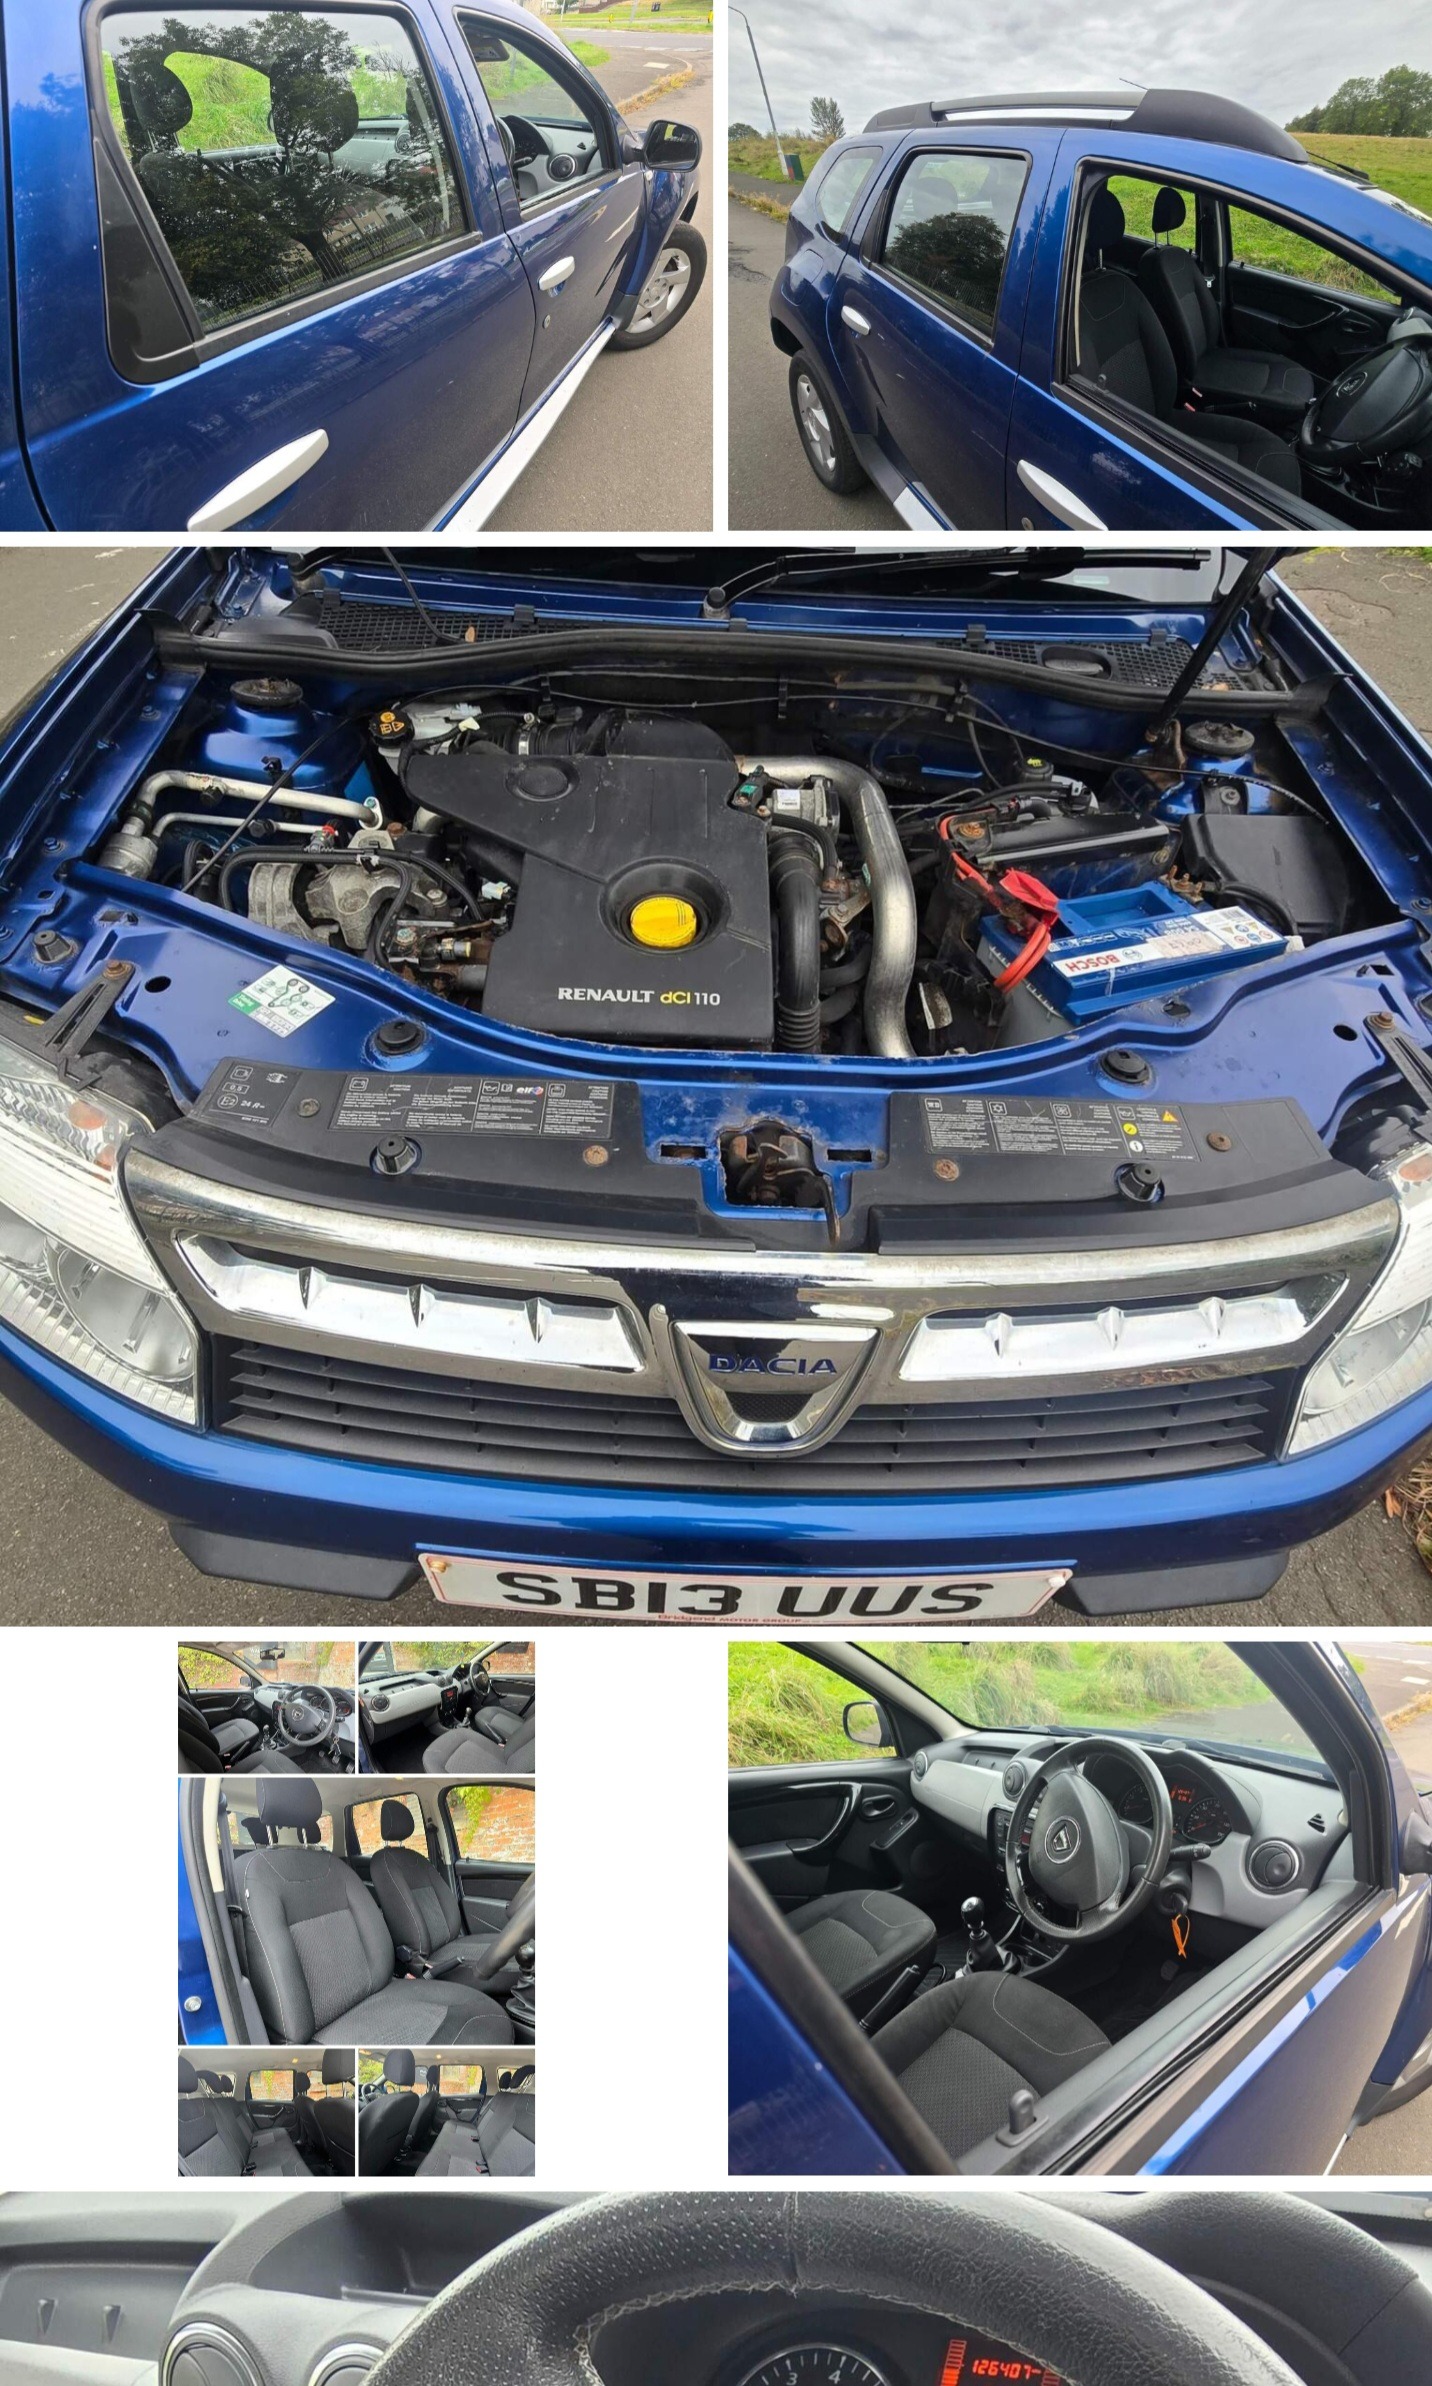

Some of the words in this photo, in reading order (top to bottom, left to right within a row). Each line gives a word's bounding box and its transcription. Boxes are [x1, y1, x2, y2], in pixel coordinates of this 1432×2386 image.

[1066, 955, 1120, 972] BOSCH
[557, 987, 655, 1003] RENAULT
[693, 992, 721, 1006] 110
[516, 1086, 534, 1094] elf
[708, 1353, 837, 1376] DACIA
[496, 1571, 742, 1616] SB13
[776, 1583, 995, 1617] UUS
[786, 2372, 798, 2386] 3
[828, 2369, 841, 2384] 4
